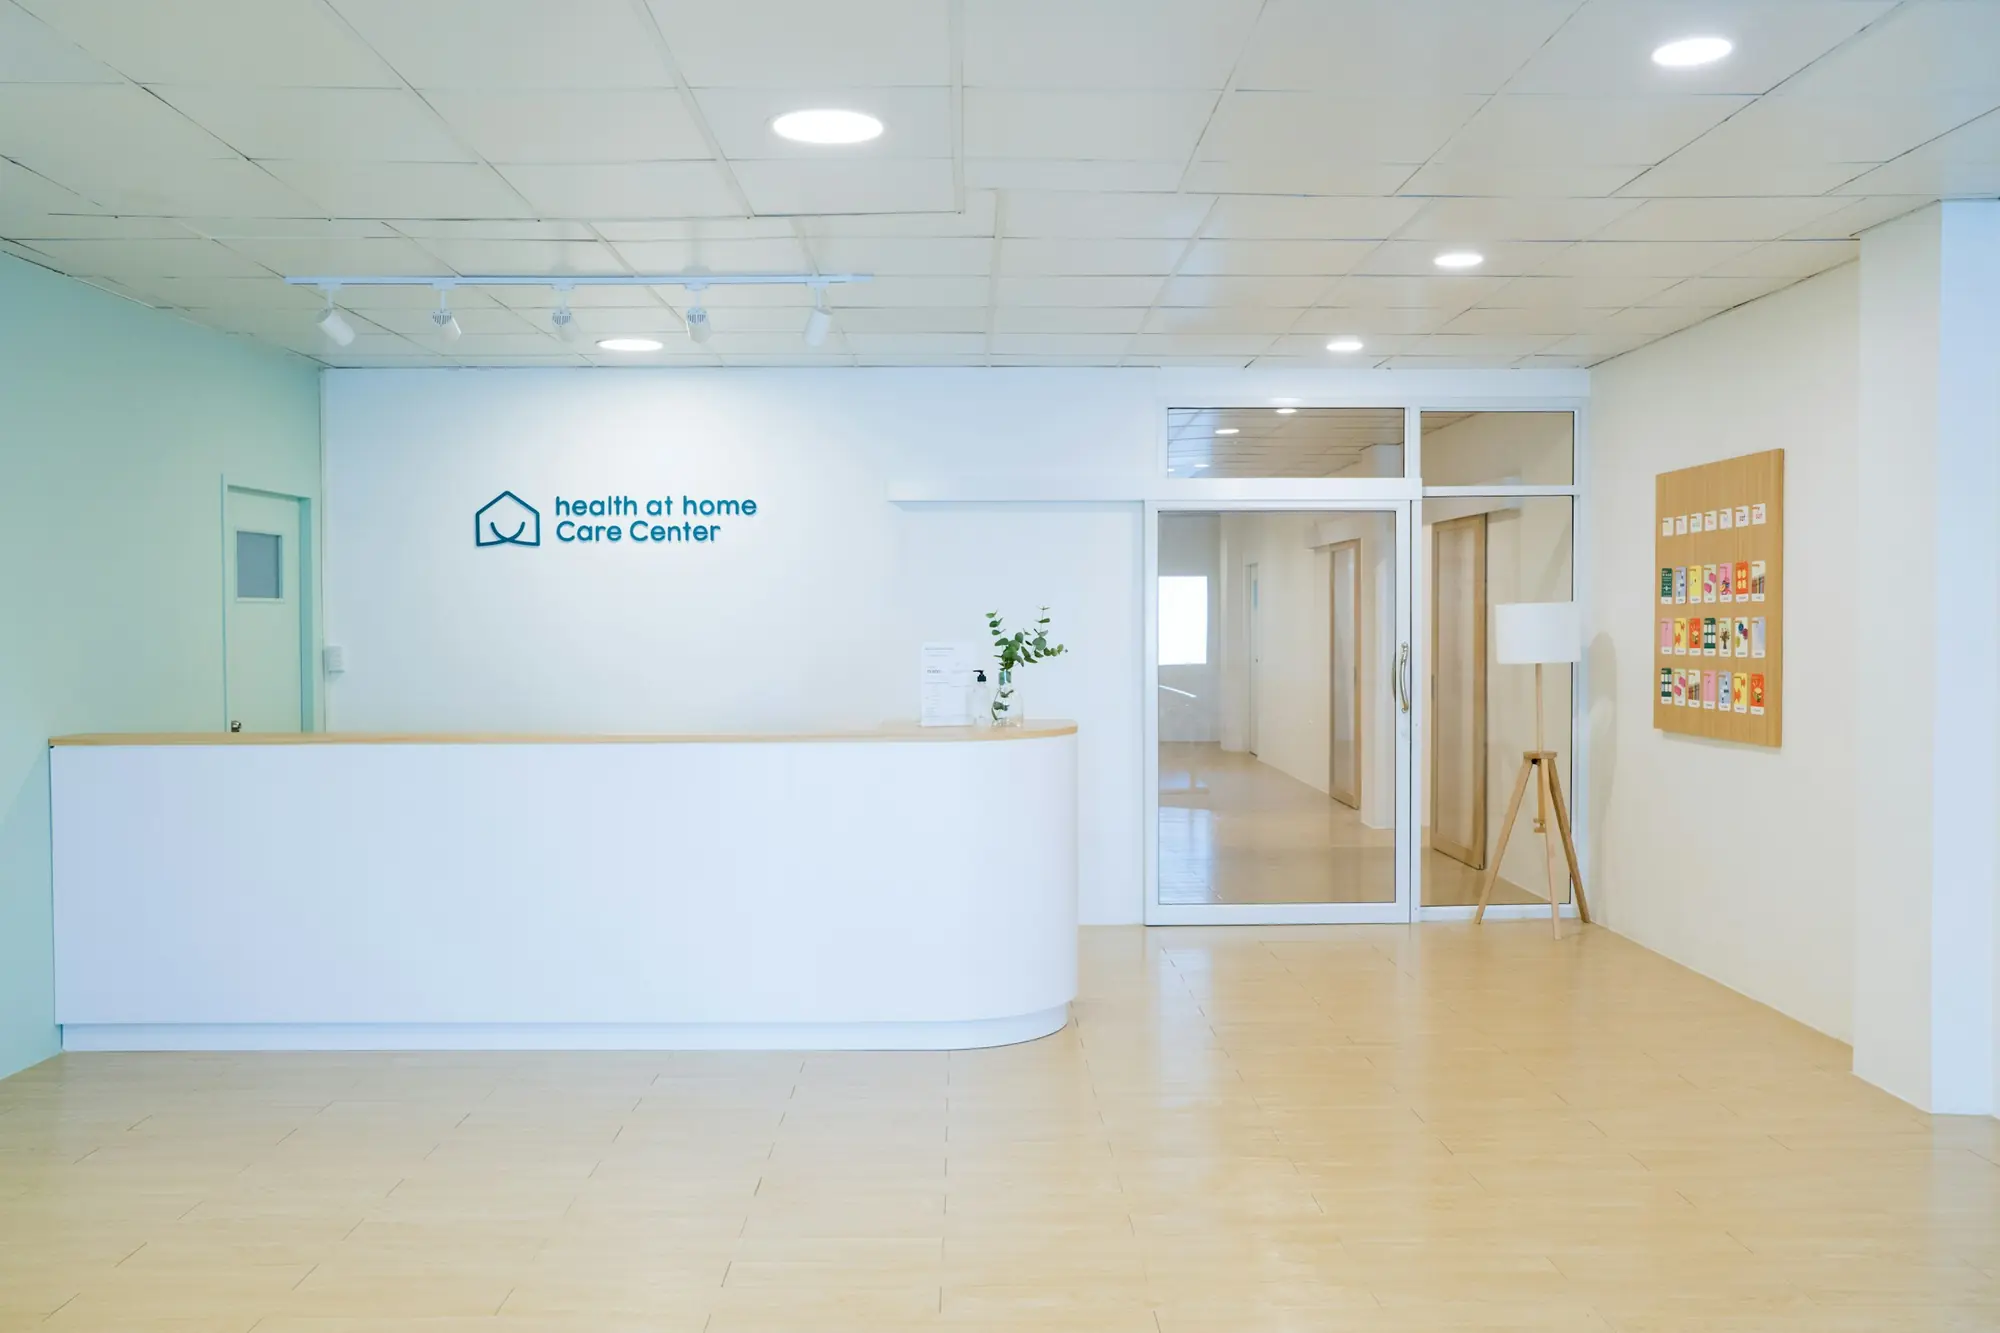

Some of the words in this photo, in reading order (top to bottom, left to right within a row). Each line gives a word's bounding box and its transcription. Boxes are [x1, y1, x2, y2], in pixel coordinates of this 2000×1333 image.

[555, 495, 638, 516] health
[645, 495, 673, 516] at
[682, 495, 757, 516] home
[555, 520, 622, 542] Care
[629, 520, 721, 542] Center
